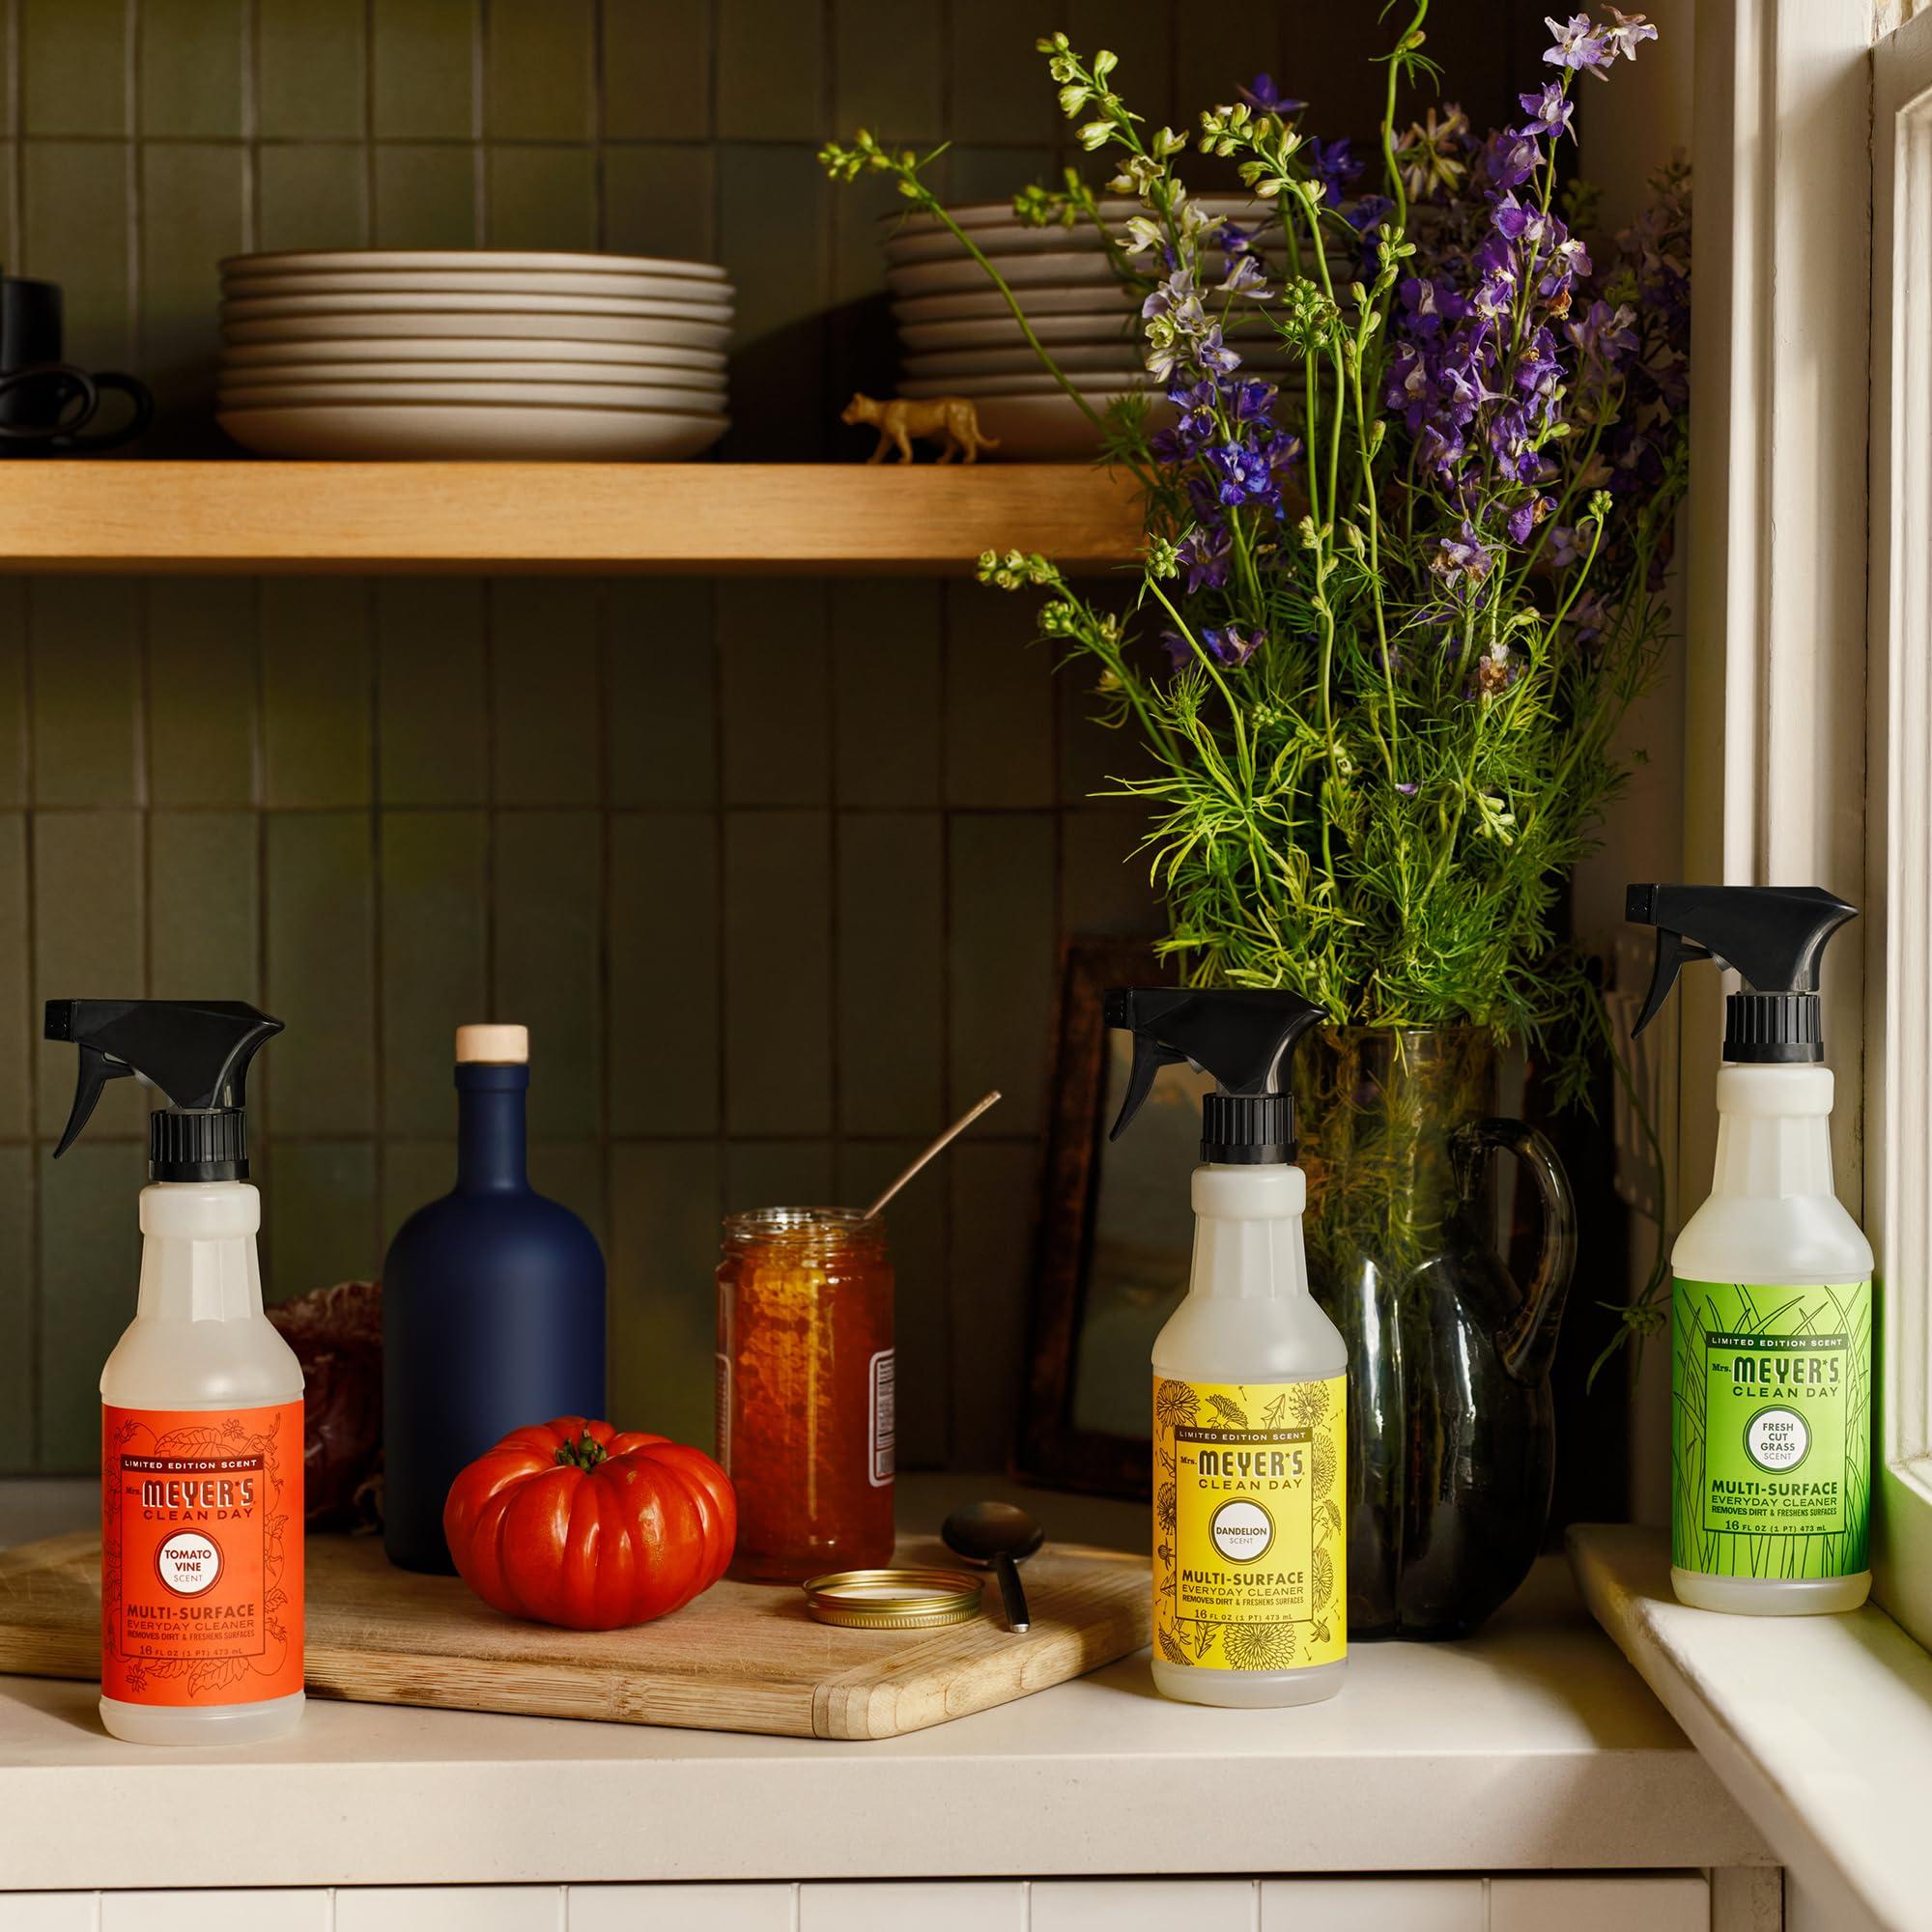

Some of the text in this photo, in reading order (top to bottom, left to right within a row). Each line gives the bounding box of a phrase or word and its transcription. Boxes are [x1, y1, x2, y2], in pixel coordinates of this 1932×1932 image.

[1712, 1337, 1754, 1347] LIMITED
[1712, 1357, 1839, 1384] Mrs. MEYER'S
[1733, 1387, 1838, 1398] CLEAN DAY
[1179, 1431, 1217, 1440] LIMITED
[1222, 1433, 1267, 1441] EDITION
[125, 1460, 162, 1469] LIMITED
[221, 1460, 257, 1468] SCENT
[1180, 1450, 1303, 1477] Mrs. MEYER'S
[1199, 1479, 1302, 1490] CLEAN DAY
[1712, 1479, 1837, 1496] MULTI-SURFACE
[142, 1479, 255, 1508] MEYER'S
[1712, 1495, 1837, 1507] EVERYDAY CLEANER
[143, 1508, 253, 1520] CLEAN DAY
[1712, 1505, 1747, 1516] REMOVES
[1749, 1507, 1767, 1516] DIRT
[1777, 1508, 1808, 1517] FRESHENS
[1810, 1507, 1837, 1516] SURFACES
[1216, 1526, 1266, 1535] DANDELION
[1725, 1520, 1739, 1530] 16
[165, 1549, 212, 1559] TOMATO
[175, 1562, 201, 1572] VINE
[1182, 1570, 1304, 1586] MULTI-SURFACE
[1182, 1585, 1304, 1596] EVERYDAY CLEANER
[1182, 1596, 1214, 1605] REMOVES
[1216, 1597, 1233, 1605] DIRT
[128, 1604, 255, 1620] MULTI-SURFACE
[1195, 1609, 1208, 1619] 16
[128, 1620, 254, 1631] EVERYDAY CLEANER
[128, 1631, 159, 1640] REMOVES
[189, 1632, 222, 1640] FRESHENS
[224, 1631, 255, 1639] SURFACES
[140, 1645, 152, 1655] 16
